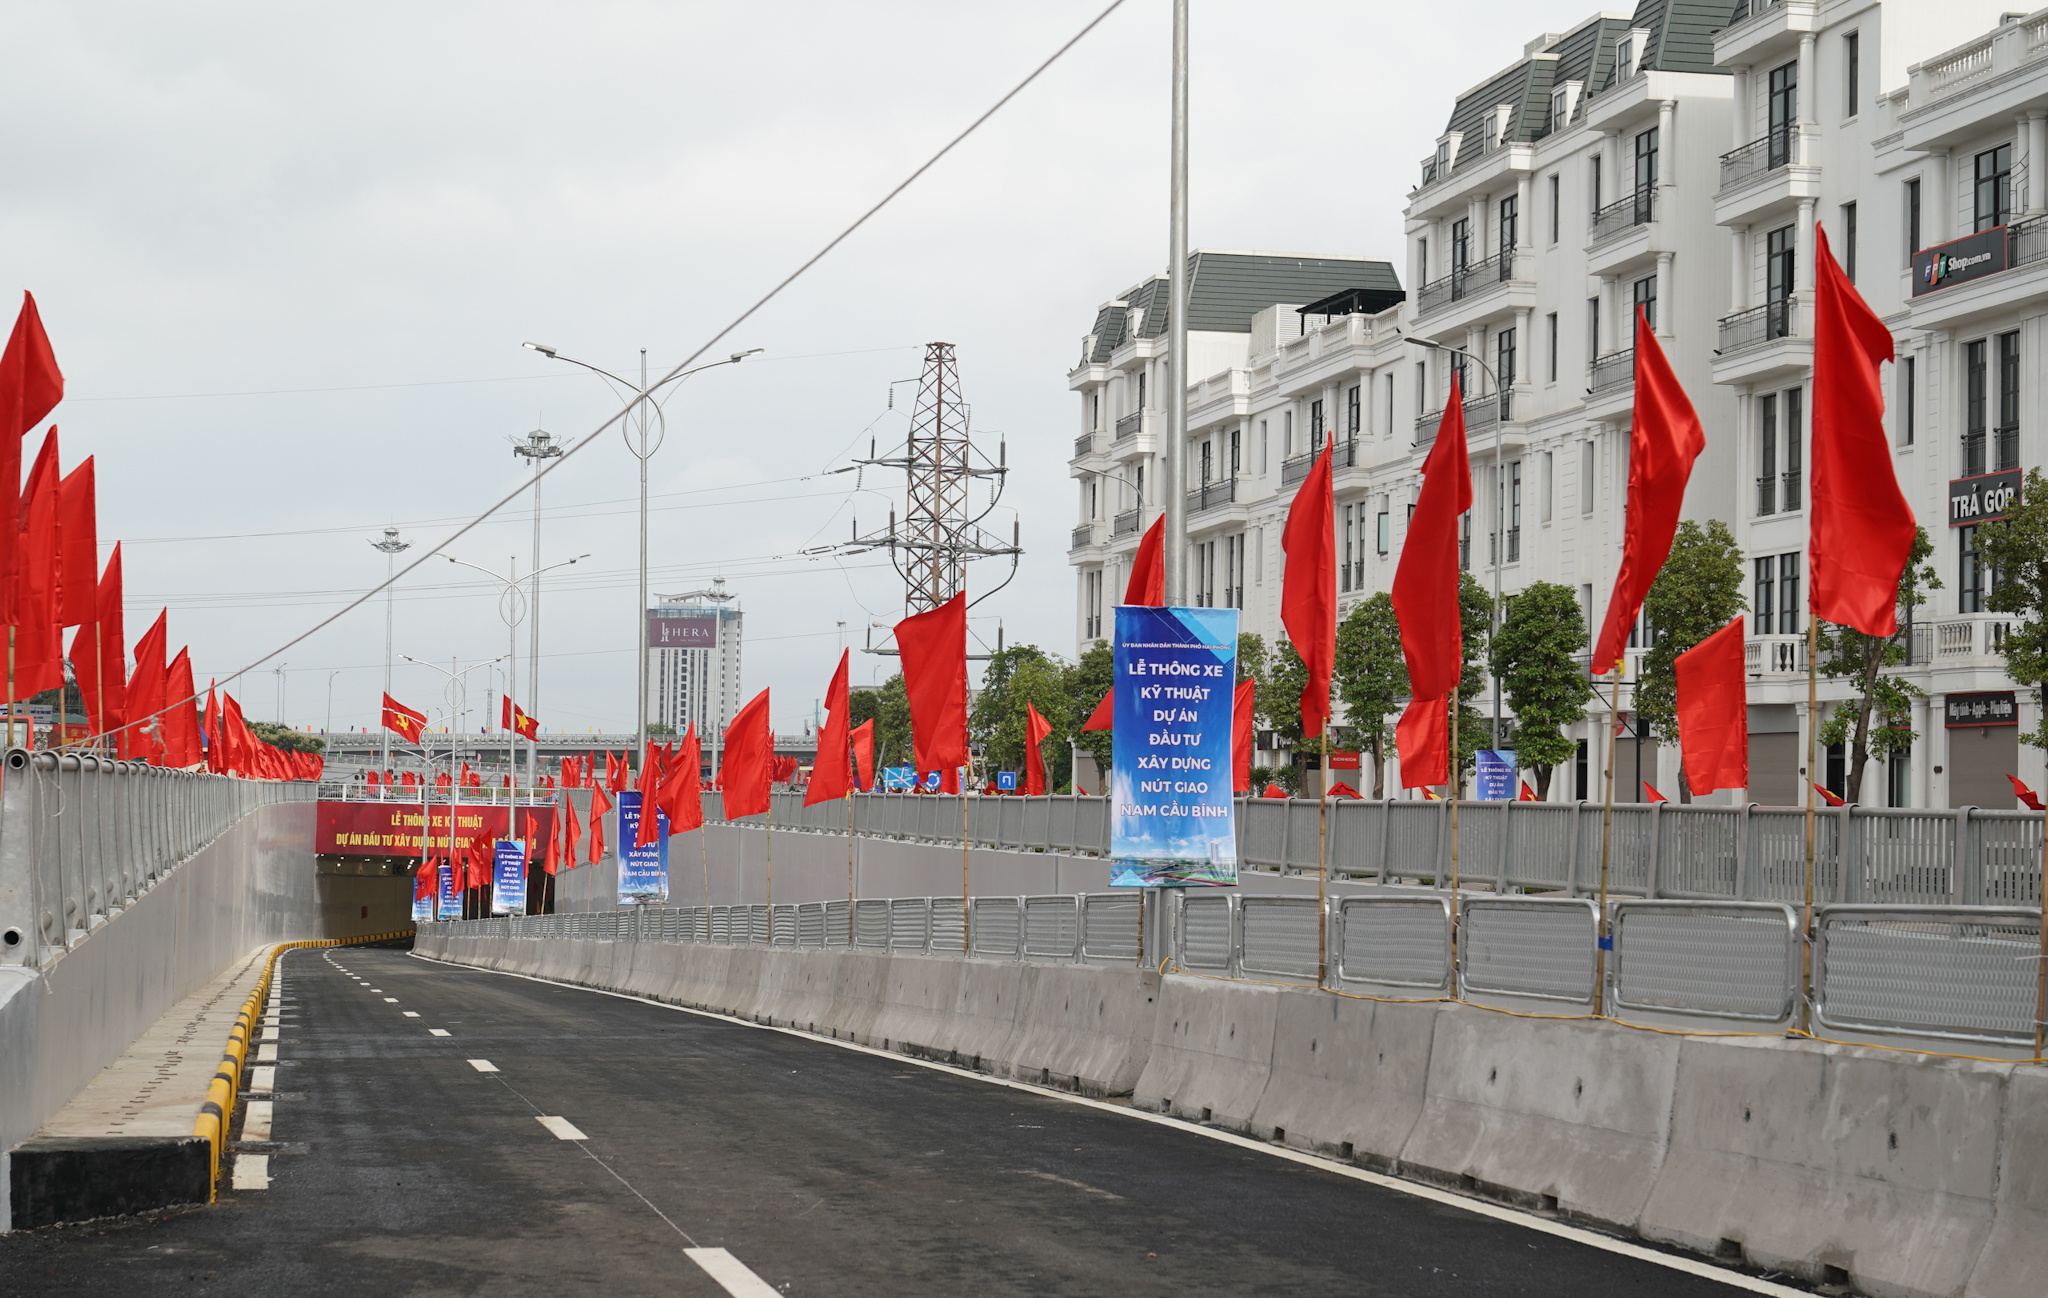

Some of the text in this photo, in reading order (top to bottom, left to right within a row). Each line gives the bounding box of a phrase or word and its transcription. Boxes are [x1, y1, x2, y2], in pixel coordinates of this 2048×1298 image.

[1948, 252, 1991, 271] Shop.com.vn
[1952, 483, 1980, 519] TRẢ
[672, 628, 709, 637] HERA
[1128, 658, 1223, 678] LỄ THÔNG XE
[1141, 684, 1211, 704] KỸ THUẬT
[1154, 708, 1197, 726] DỰ ÁN
[1949, 702, 1960, 720] Máy
[1972, 701, 1987, 718] Apple
[1149, 727, 1202, 746] ĐẦU TƯ
[1137, 755, 1211, 774] XÂY DỰNG
[1141, 777, 1208, 794] NÚT GIAO
[1121, 799, 1228, 818] NAM CẦU BÍNH
[391, 811, 401, 826] LỄ
[432, 816, 442, 827] XE
[458, 814, 484, 830] THUẬT
[336, 832, 349, 847] DỰ
[350, 832, 362, 846] ÁN
[363, 831, 380, 846] ĐẦU
[382, 834, 394, 846] TƯ
[394, 833, 410, 847] XÂY
